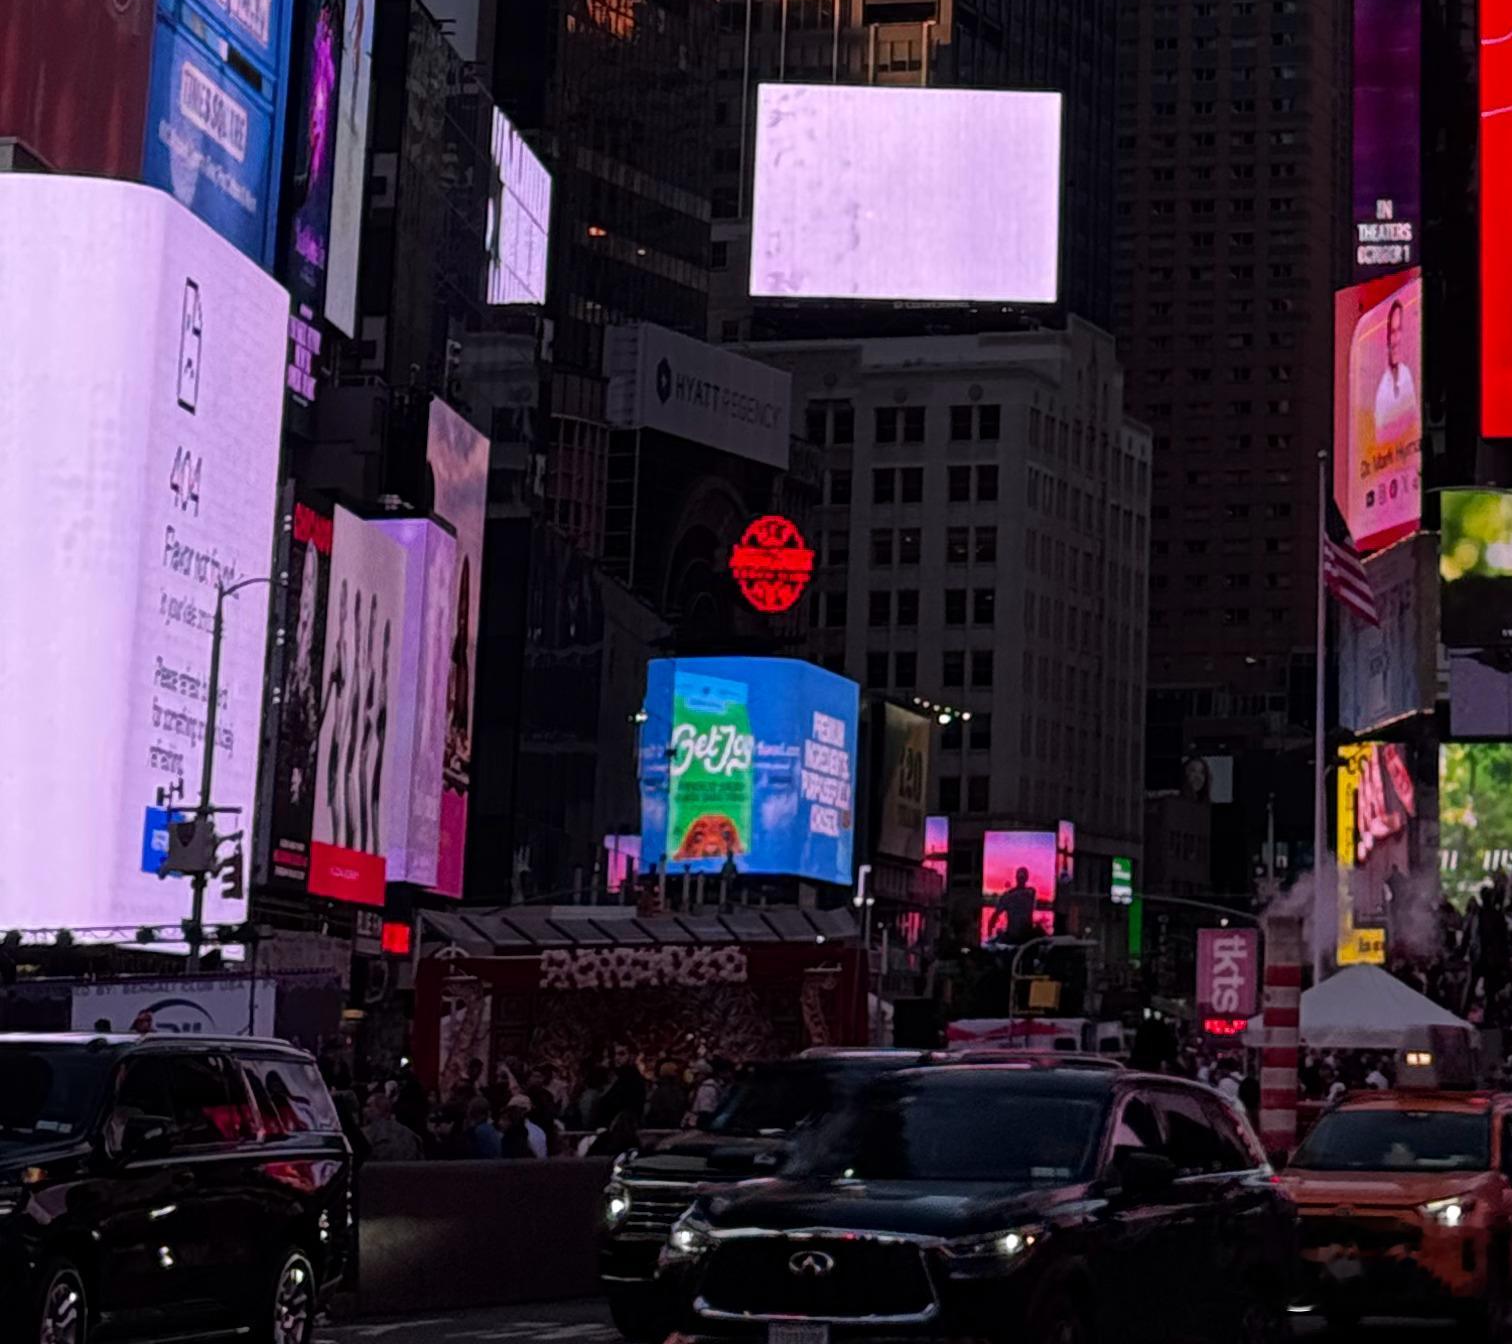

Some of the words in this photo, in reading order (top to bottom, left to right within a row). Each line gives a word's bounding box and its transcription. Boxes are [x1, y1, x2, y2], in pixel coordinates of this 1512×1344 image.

[1376, 199, 1393, 220] IN
[675, 372, 720, 412] HYATT
[1212, 934, 1248, 1013] tkts
